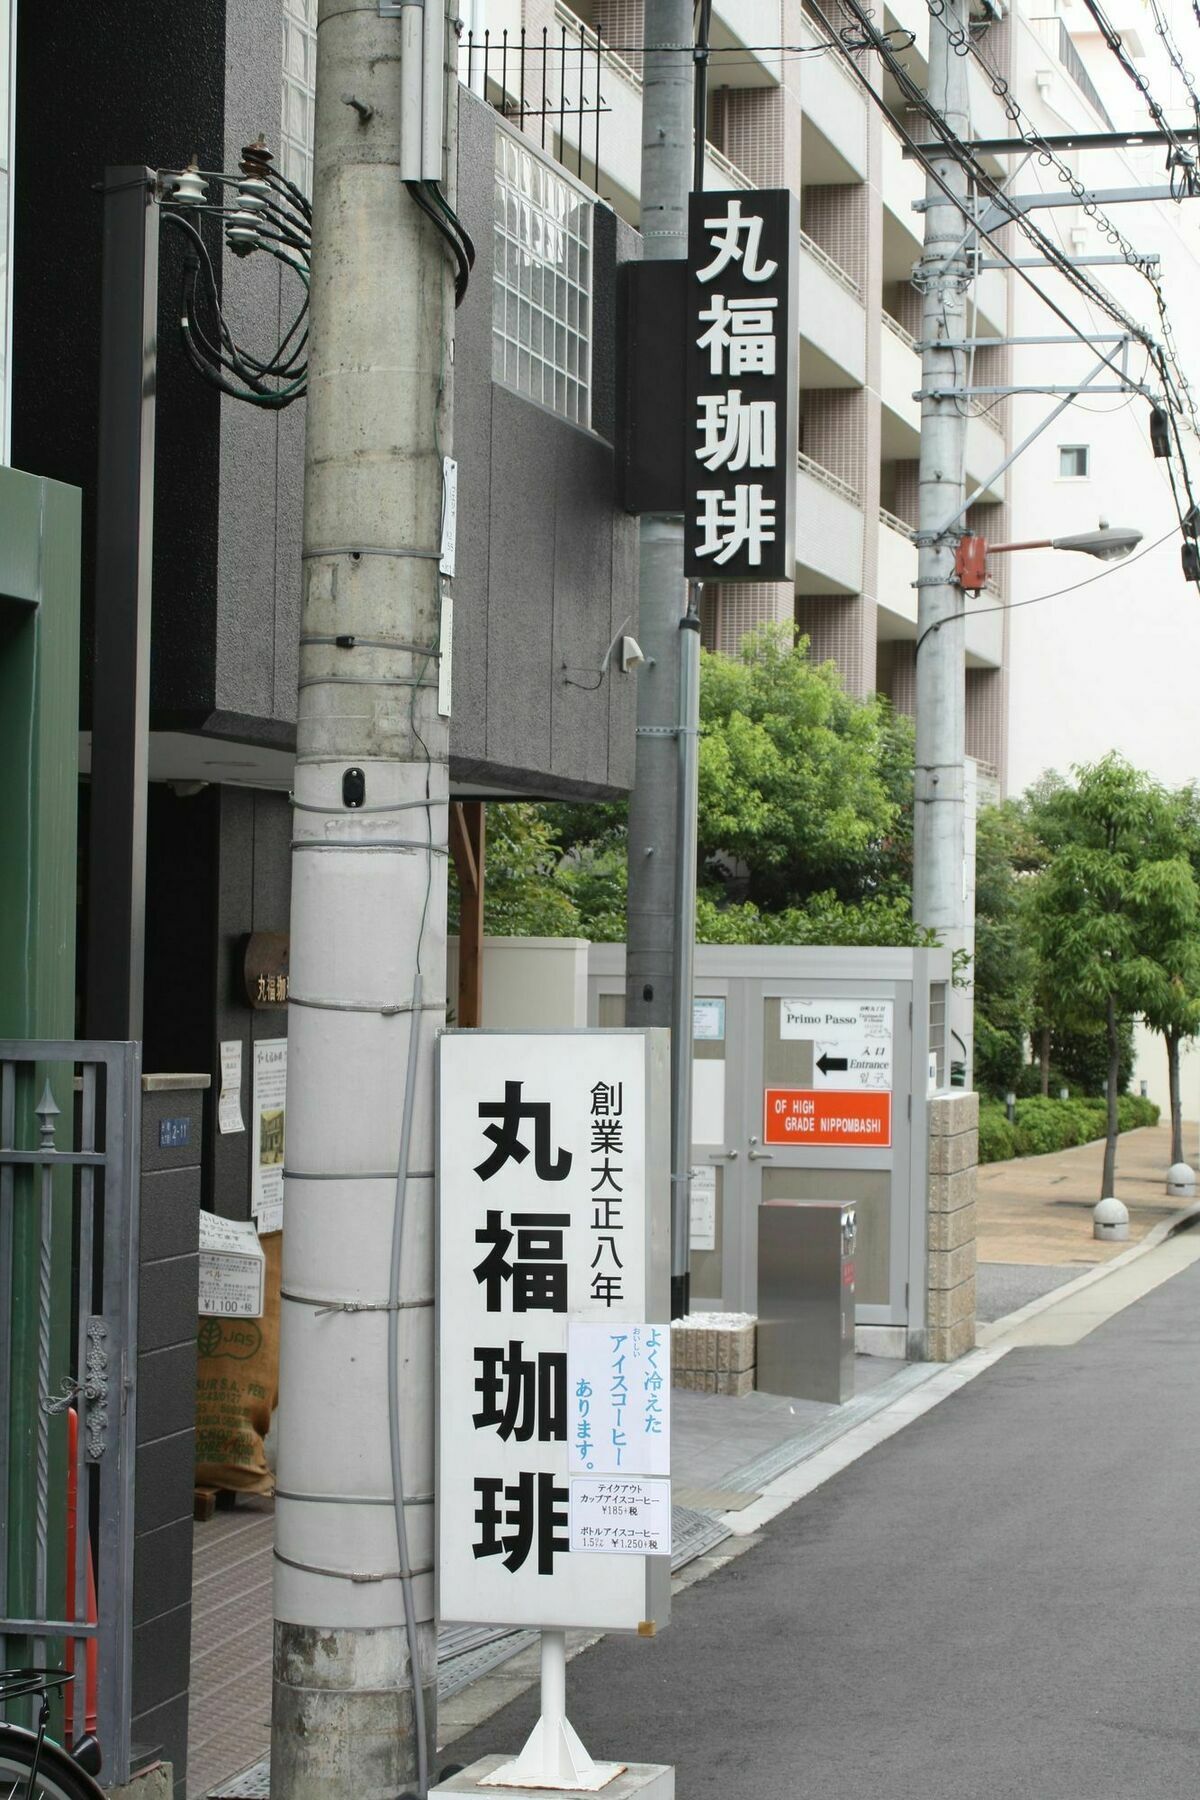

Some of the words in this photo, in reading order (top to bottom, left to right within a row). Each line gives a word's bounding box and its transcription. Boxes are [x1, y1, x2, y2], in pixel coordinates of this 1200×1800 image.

[695, 199, 779, 566] 丸福珈琲
[786, 1013, 821, 1025] Primo
[825, 1014, 857, 1025] Passo
[849, 1059, 890, 1070] Entrance
[774, 1099, 788, 1114] OF
[792, 1100, 815, 1114] HIGH
[784, 1117, 815, 1132] GRADE
[820, 1118, 881, 1133] NIPPOMBASHI
[590, 1081, 623, 1308] 創業大正八年
[472, 1080, 572, 1576] 丸福珈琲
[633, 1327, 641, 1358] おいしい
[644, 1328, 664, 1434] よく冷えた
[610, 1334, 628, 1466] アイスコーヒー
[575, 1377, 594, 1470] あります。
[580, 1494, 660, 1504] カップアイスコーヒー
[598, 1484, 642, 1493] テイクアウト
[580, 1526, 660, 1538] ボトルアイスコーヒー
